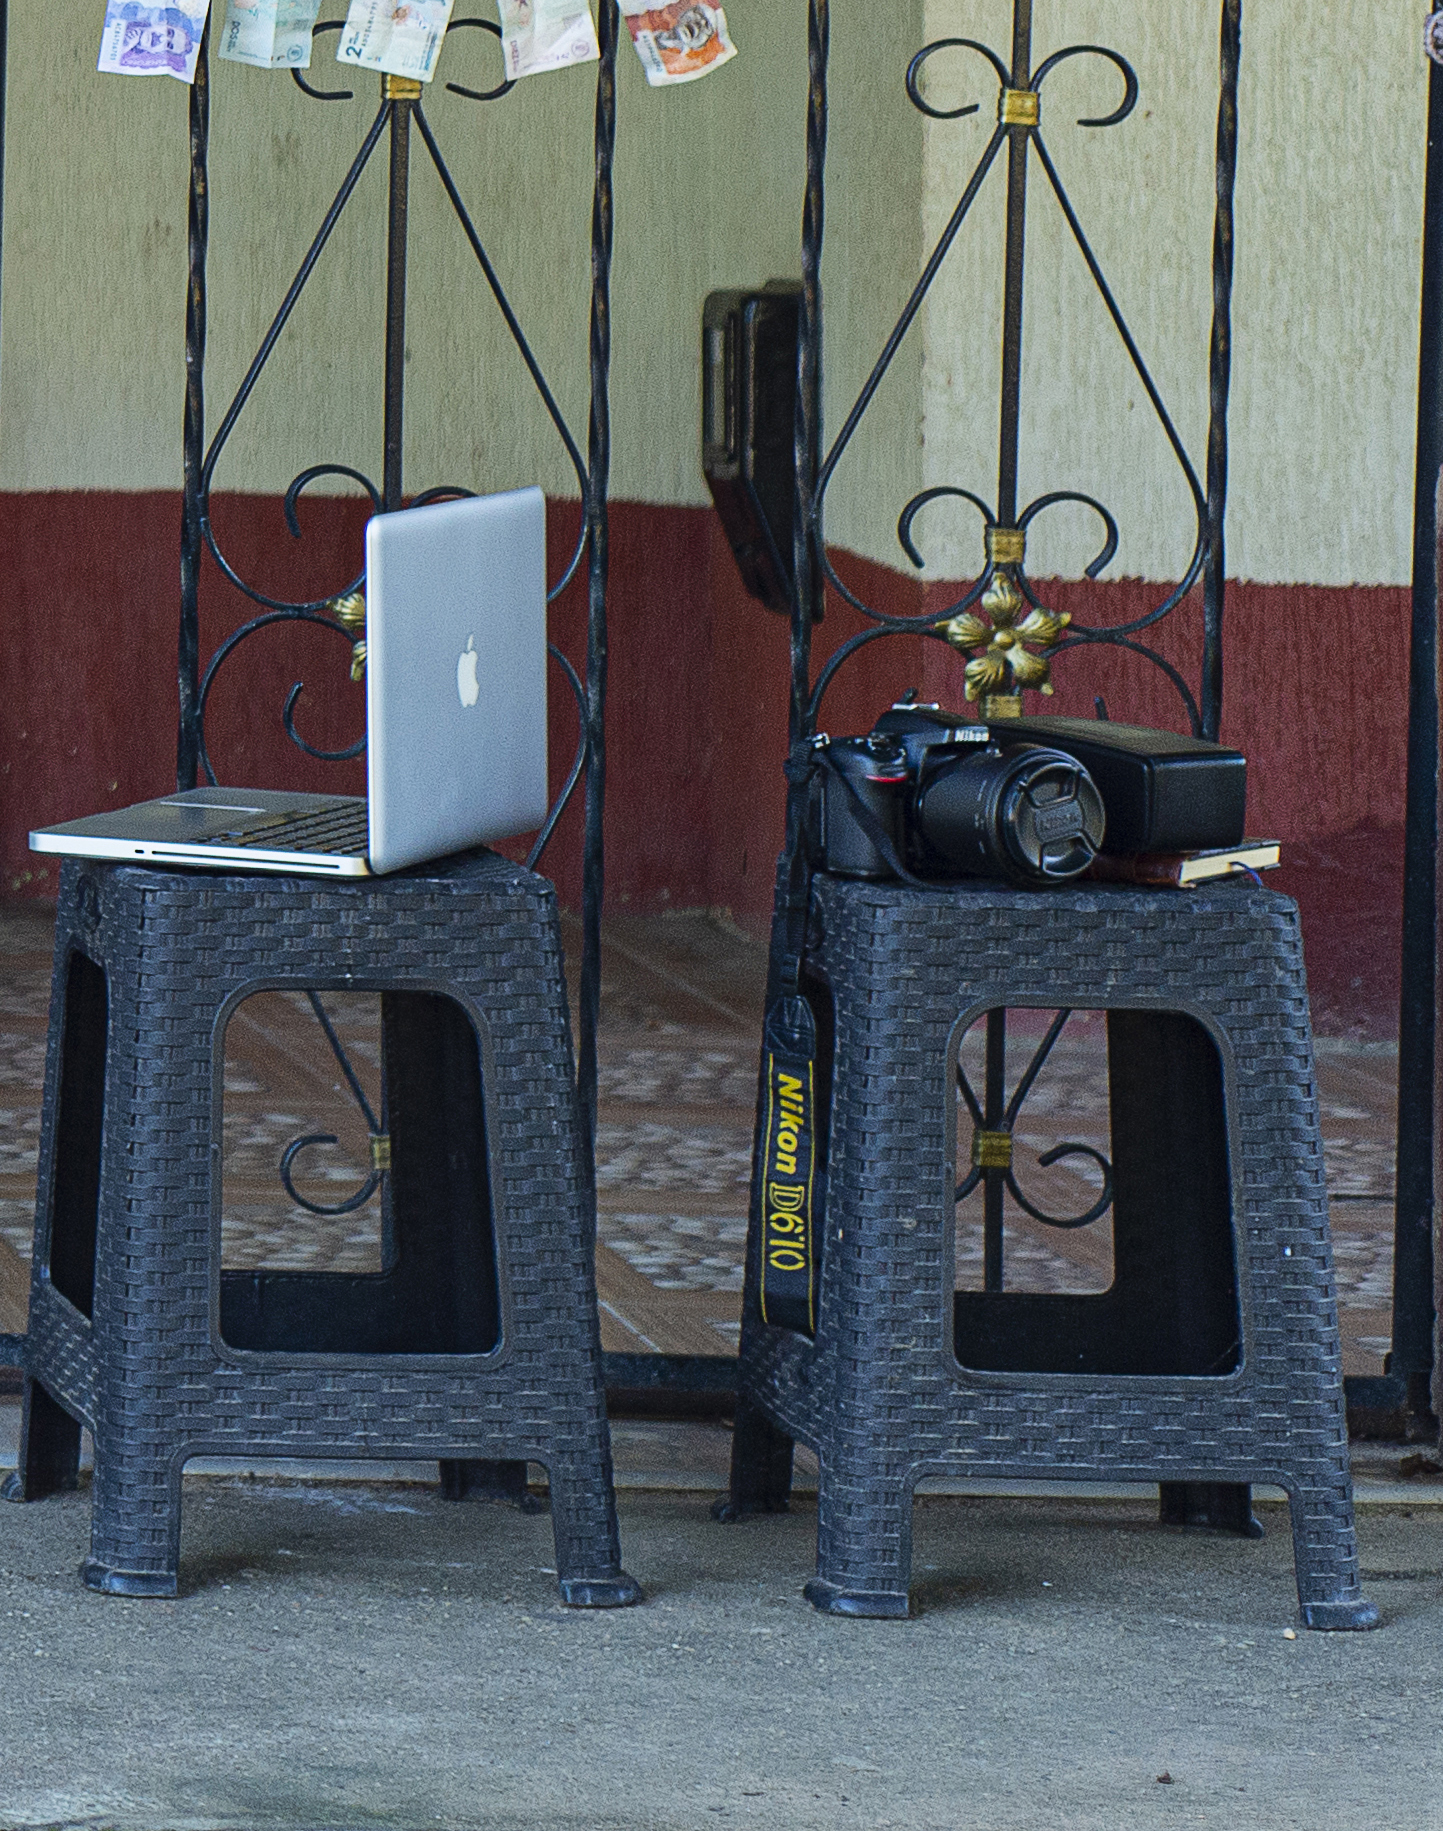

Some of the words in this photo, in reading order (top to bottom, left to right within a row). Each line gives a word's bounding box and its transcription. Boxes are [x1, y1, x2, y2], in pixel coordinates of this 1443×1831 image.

[345, 45, 364, 59] 2
[954, 728, 990, 742] Nikon
[775, 1072, 806, 1176] Nikon
[768, 1181, 808, 1272] D610
